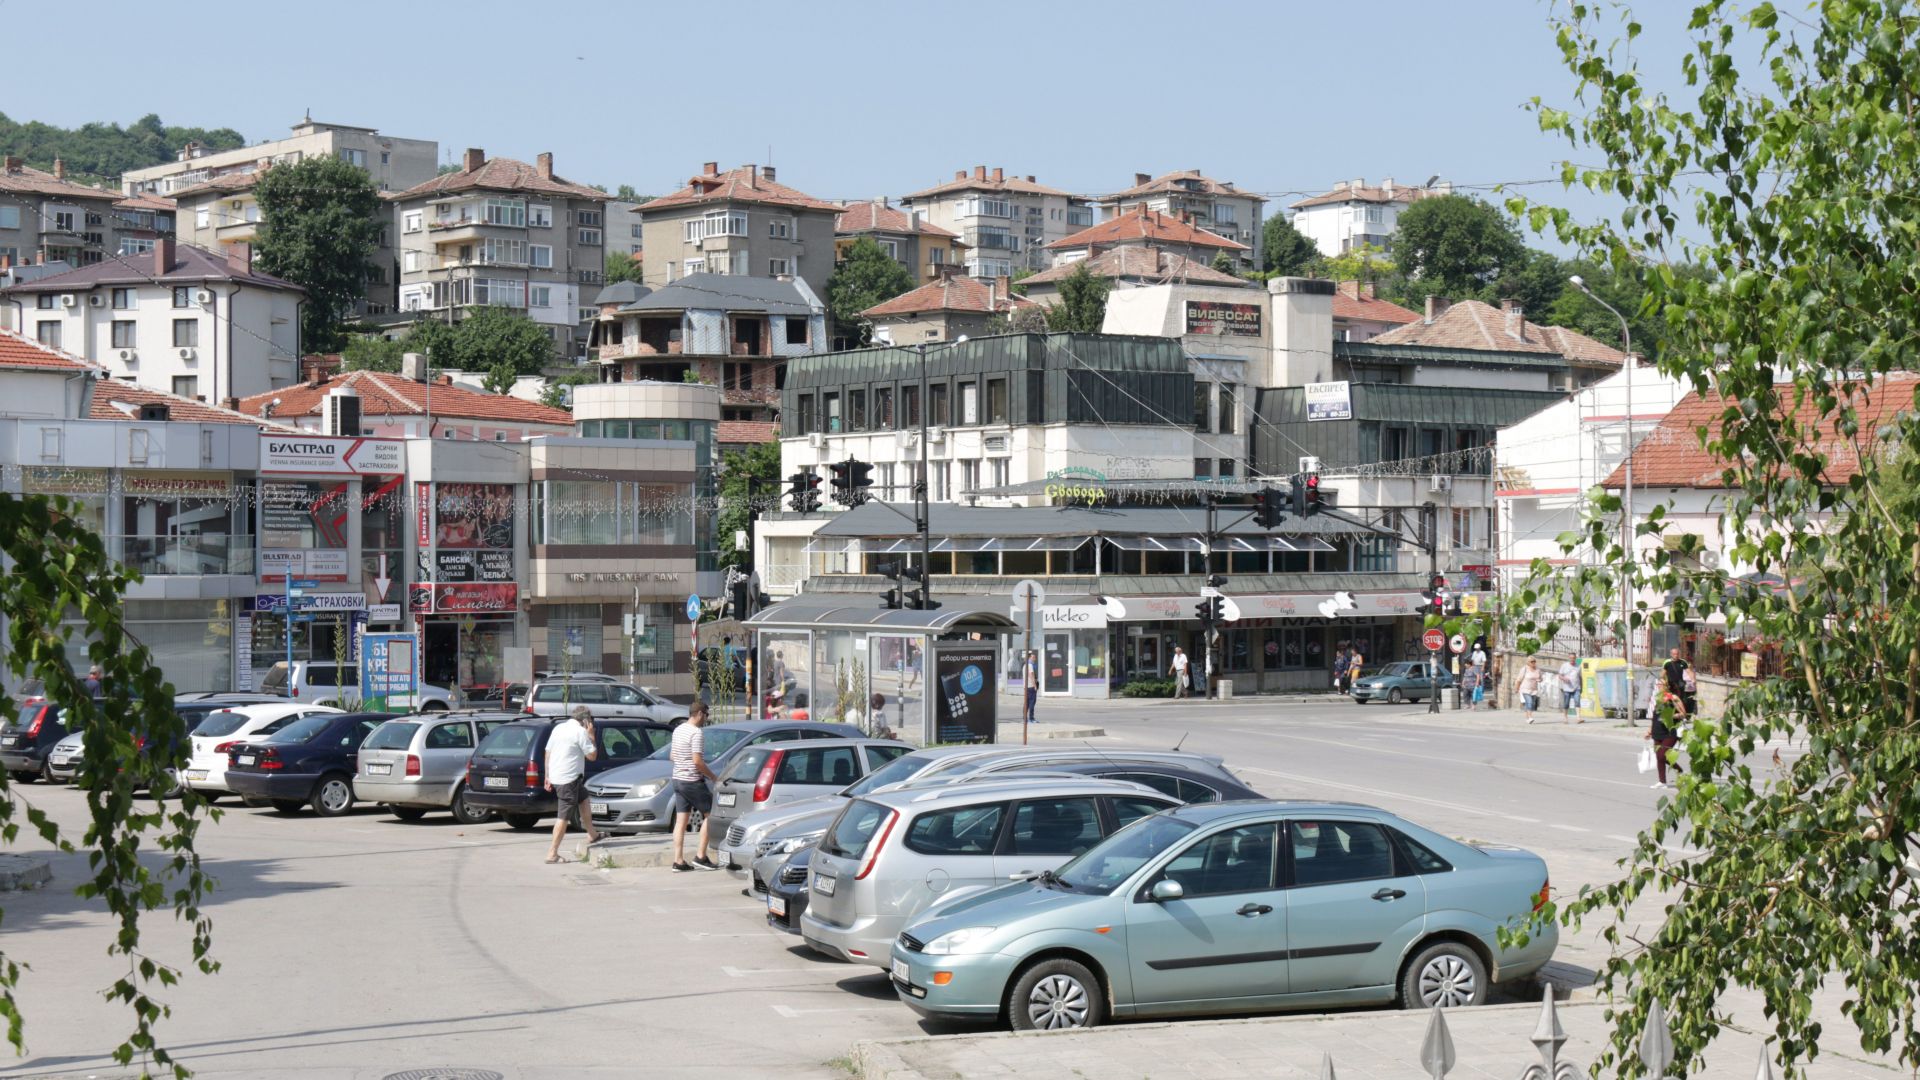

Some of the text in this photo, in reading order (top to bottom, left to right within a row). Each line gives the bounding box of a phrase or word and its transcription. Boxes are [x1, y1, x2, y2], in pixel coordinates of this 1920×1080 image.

[1188, 309, 1259, 321] ВИДЕОСАТ
[440, 556, 470, 564] БАНСКИ
[483, 571, 507, 579] БЕЛЬО
[1425, 635, 1442, 644] STOP
